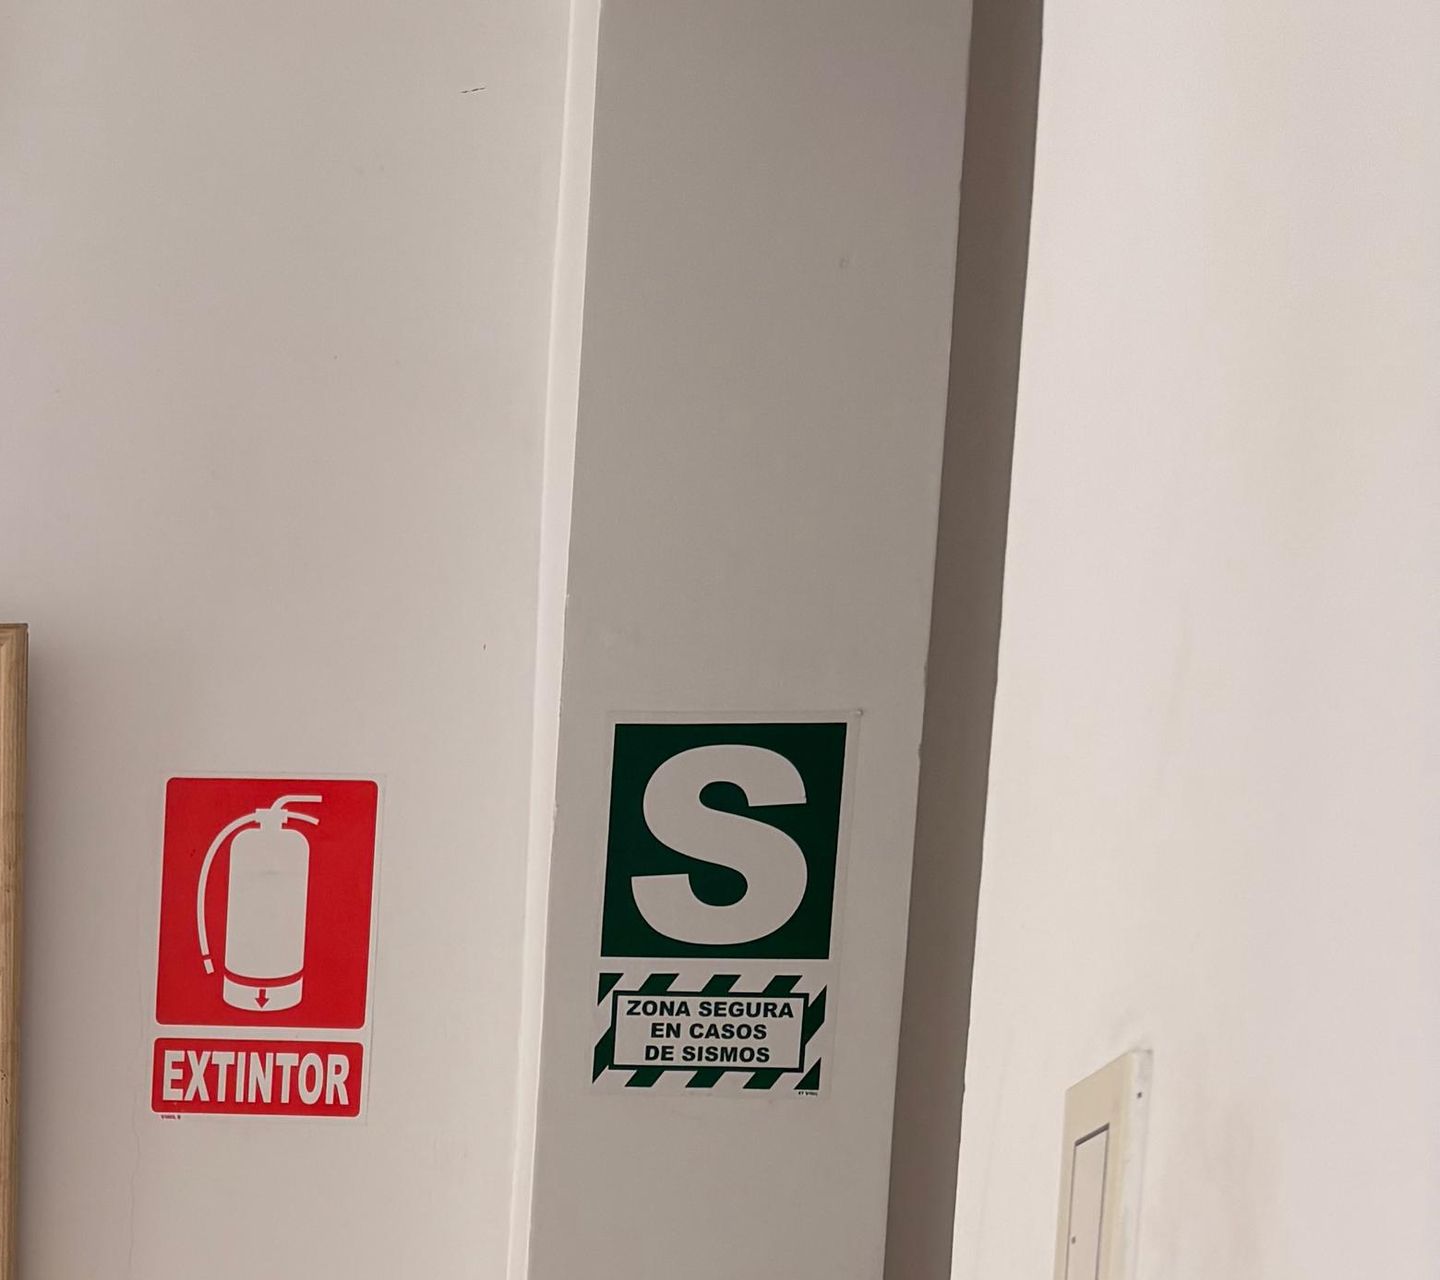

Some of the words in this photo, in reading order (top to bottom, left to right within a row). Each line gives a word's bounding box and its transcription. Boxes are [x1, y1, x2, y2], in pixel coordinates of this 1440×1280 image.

[631, 744, 808, 945] S
[626, 1000, 691, 1018] ZONA
[698, 1000, 794, 1018] SEGURA
[650, 1022, 681, 1039] EN
[689, 1022, 767, 1040] CASOS
[645, 1045, 674, 1062] DE
[682, 1046, 770, 1063] SISMOS
[162, 1050, 350, 1105] EXTINTOR
